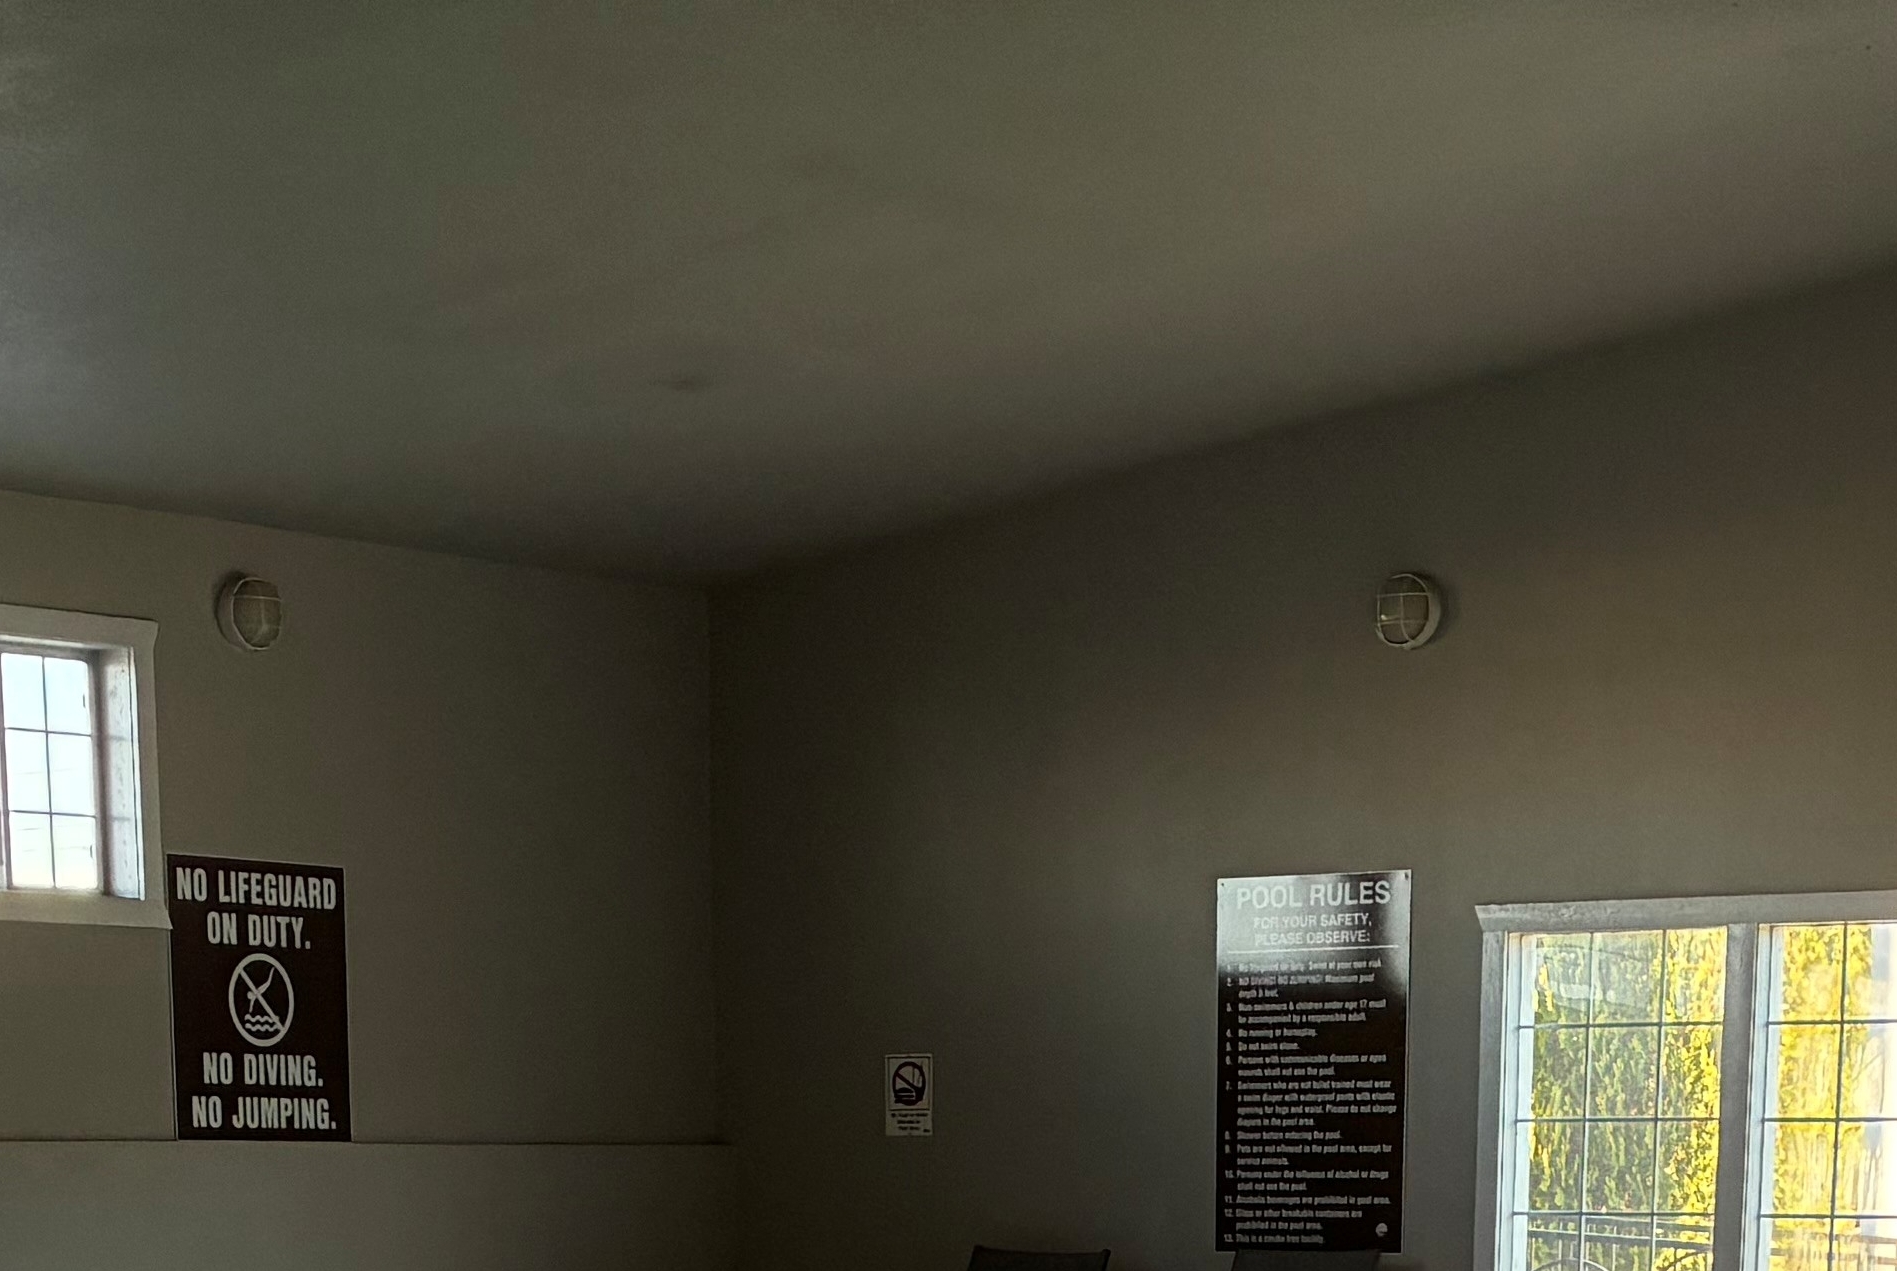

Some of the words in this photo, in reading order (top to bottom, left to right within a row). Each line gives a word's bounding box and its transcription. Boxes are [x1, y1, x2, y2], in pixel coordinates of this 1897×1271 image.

[176, 867, 208, 901] NO
[218, 869, 337, 910] LIFEGUARD
[1237, 885, 1303, 909] POOL
[1310, 881, 1391, 906] RULES
[207, 911, 238, 945] ON
[248, 915, 311, 950] DUTY.
[1254, 916, 1279, 929] FOR
[1283, 914, 1317, 928] YOUR
[1320, 912, 1372, 927] SAFETY,
[1255, 931, 1303, 946] PLEASE
[1306, 929, 1371, 945] OBSERVE:
[203, 1052, 233, 1085] NO
[244, 1054, 324, 1087] DIVING.
[192, 1095, 223, 1128] NO
[232, 1097, 337, 1130] JUMPING.
